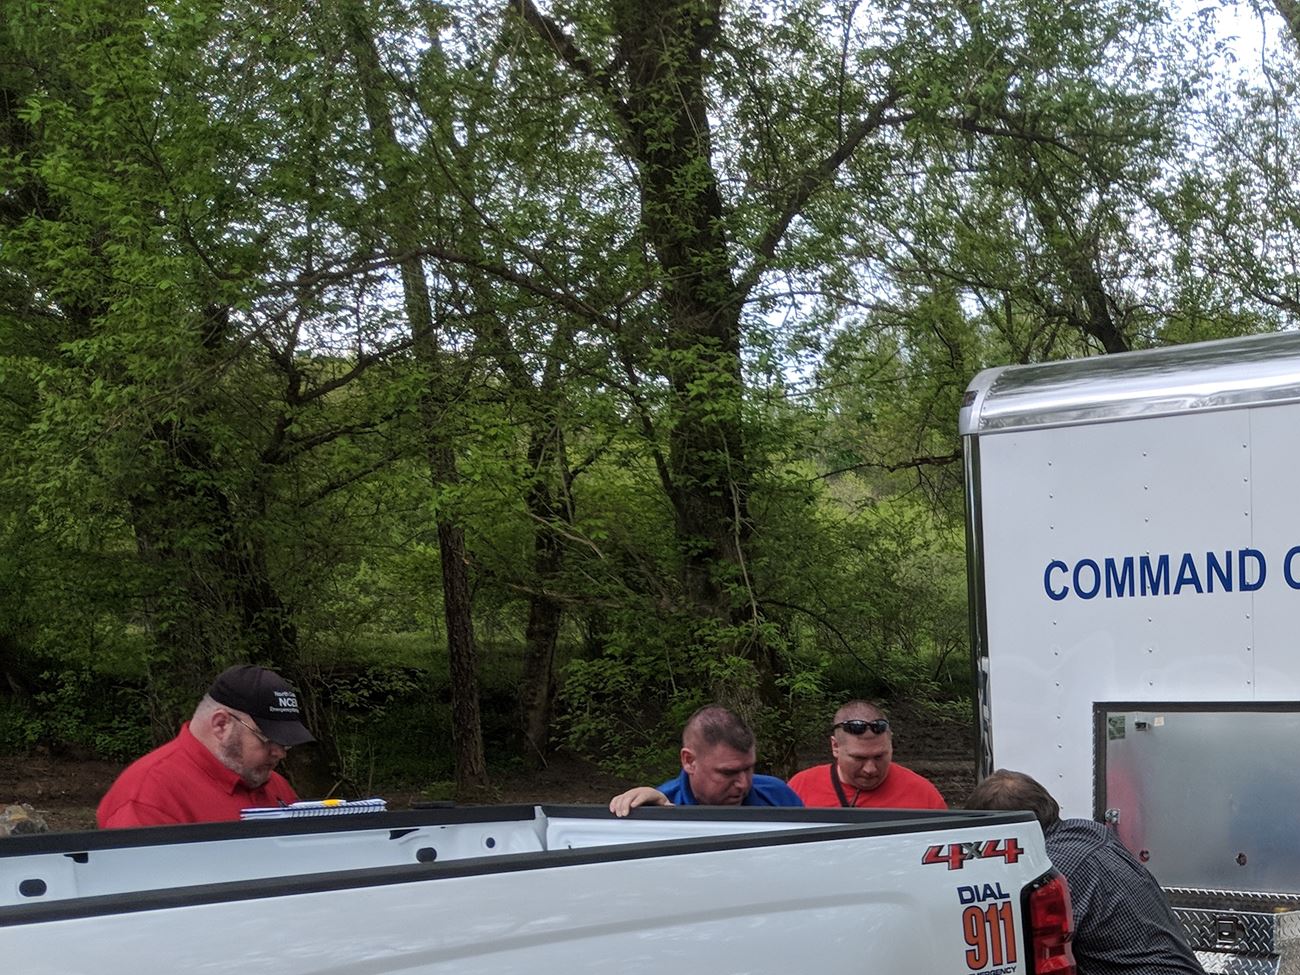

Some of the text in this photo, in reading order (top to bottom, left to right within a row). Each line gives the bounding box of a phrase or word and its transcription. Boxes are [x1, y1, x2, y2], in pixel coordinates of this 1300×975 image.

[1044, 548, 1267, 601] COMMAND
[957, 882, 1010, 904] DIAL
[962, 900, 1017, 970] 911
